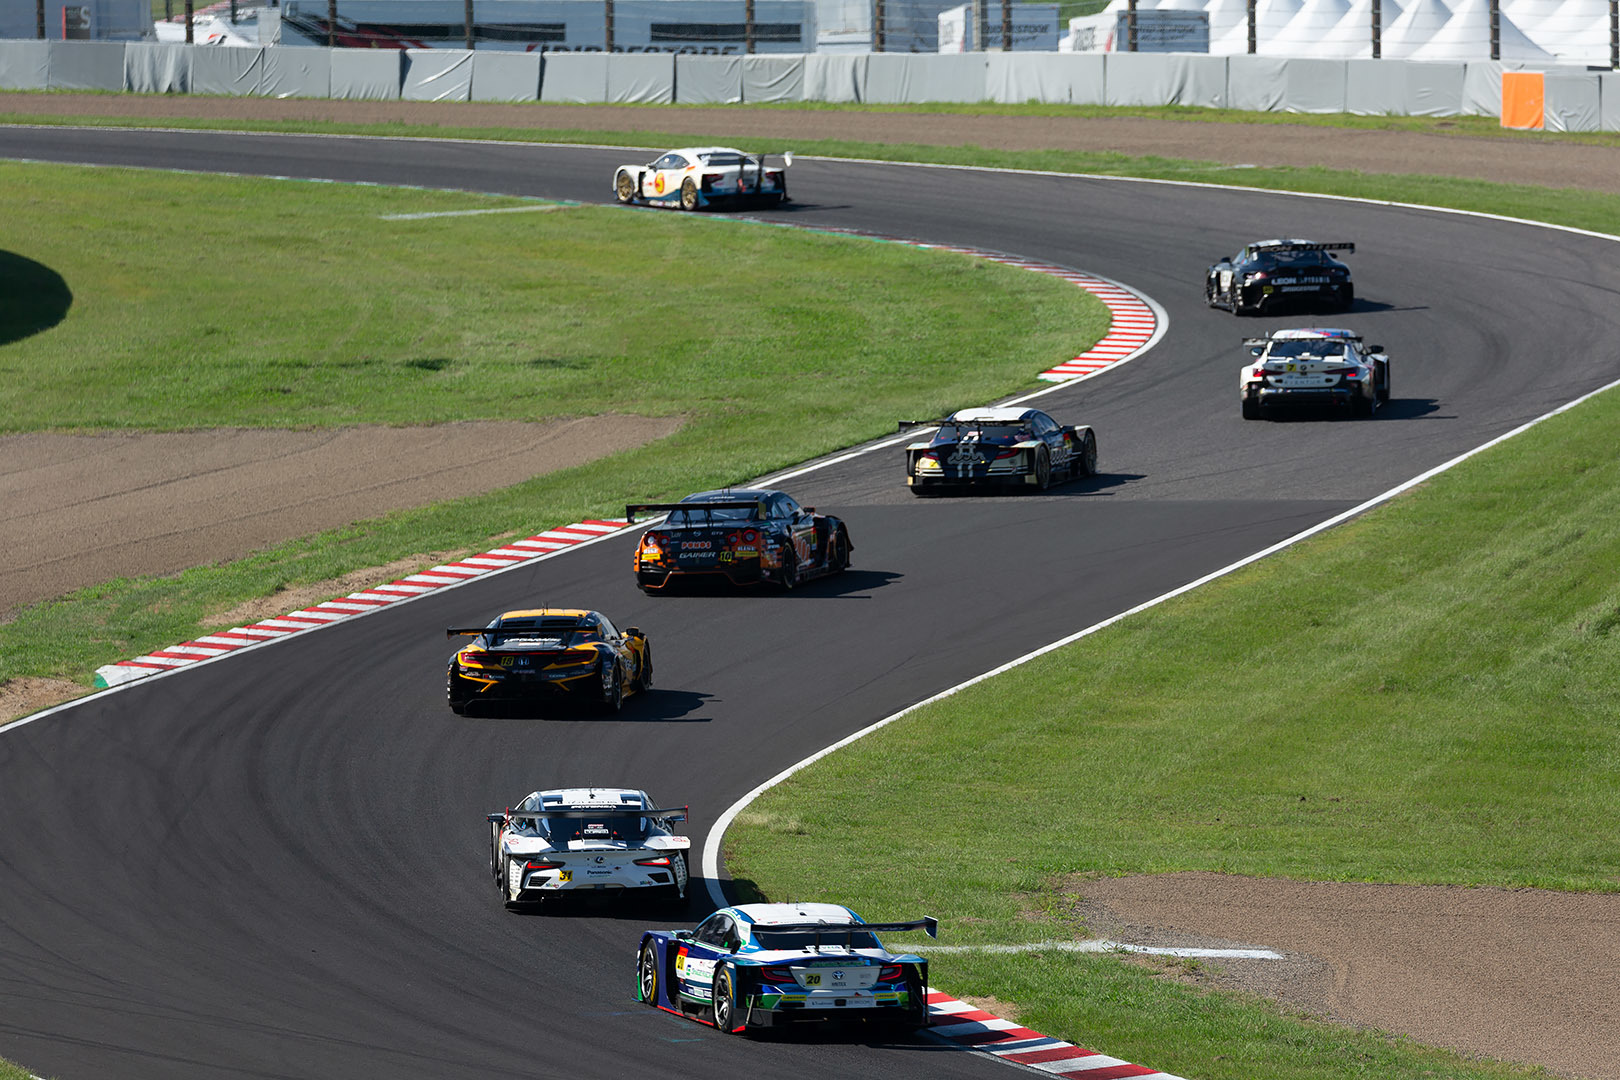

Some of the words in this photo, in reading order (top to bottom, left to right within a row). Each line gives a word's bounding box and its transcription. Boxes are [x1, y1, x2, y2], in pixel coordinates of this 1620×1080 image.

[681, 541, 712, 549] PONOS
[679, 551, 717, 559] GAINER
[560, 871, 572, 880] 31
[806, 976, 820, 984] 20
